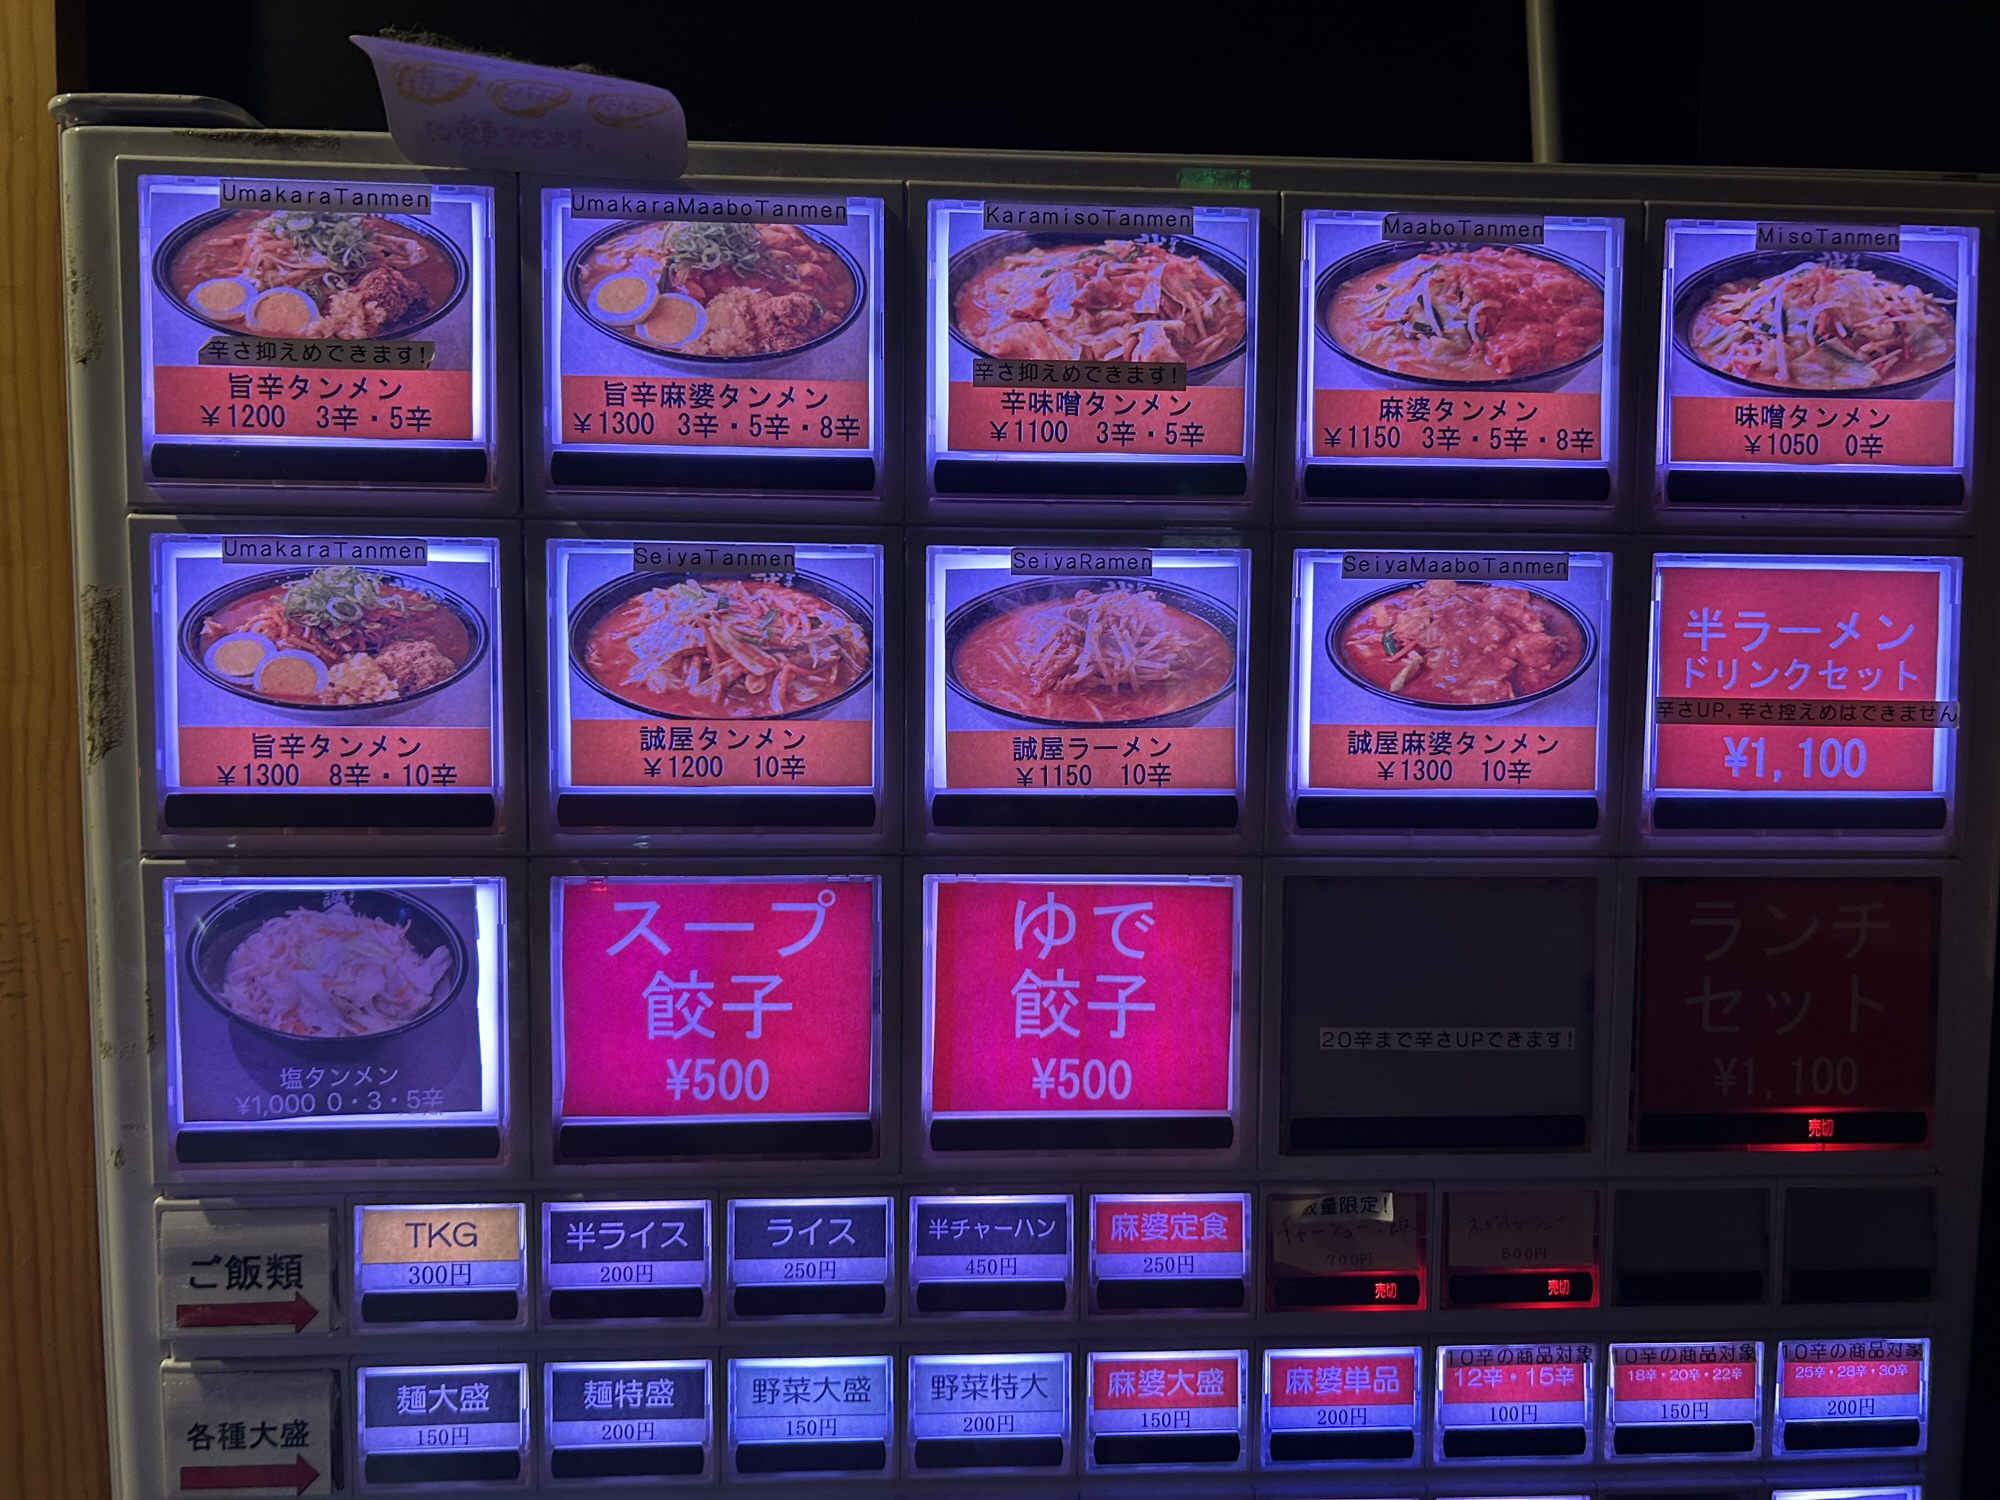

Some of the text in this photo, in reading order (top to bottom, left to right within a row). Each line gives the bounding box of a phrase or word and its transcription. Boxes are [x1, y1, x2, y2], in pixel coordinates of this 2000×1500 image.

[222, 184, 430, 208] UmakaraTanmen
[571, 194, 847, 219] UmakaraMaaboTanmen
[985, 206, 1192, 228] KaramisoTanmen
[1384, 217, 1543, 238] MaaboTanmen
[1758, 227, 1899, 247] MisoTanmen
[229, 374, 403, 400] 旨辛タンメン
[605, 381, 829, 410] 旨辛麻婆タンメン
[1001, 389, 1192, 416] 辛味噌タンメン
[1379, 396, 1538, 423] 麻婆タンメン
[201, 405, 286, 428] ¥1200
[573, 412, 655, 435] ¥1300
[1734, 404, 1891, 430] 味噌タンメン
[990, 420, 1069, 443] ¥1100
[1324, 425, 1401, 449] ¥1150
[1744, 433, 1884, 459] ¥1050 0辛
[224, 540, 426, 559] UmakaraTanmen
[634, 547, 795, 567] SeiyaTanmen
[1013, 552, 1151, 571] SeiyaRamen
[1343, 556, 1567, 575] SeiyaMaaboTanmen
[1683, 607, 1915, 651] 半ラーメン
[1685, 656, 1918, 690] ドリンクセット
[252, 733, 422, 760] 旨辛タンメン
[639, 725, 806, 752] 誠屋タンメン
[1012, 736, 1172, 762] 誠屋ラーメン
[1347, 730, 1559, 756] 誠屋麻婆タンメン
[643, 755, 806, 780] ¥1200 10辛
[1377, 759, 1532, 784] ¥1300 10辛
[1724, 736, 1867, 782] ¥1,100
[216, 763, 300, 786] ¥1300
[1016, 762, 1172, 787] ¥1150 10辛
[605, 888, 836, 957] スープ
[1013, 891, 1155, 960] ゆで
[1690, 900, 1890, 961] ランチ
[642, 969, 792, 1040] 餃子
[1010, 968, 1155, 1038] 餃子
[1684, 974, 1885, 1036] セット
[279, 1065, 398, 1089] 塩タンメン
[666, 1058, 769, 1101] ¥500
[1031, 1057, 1132, 1100] ¥500
[1808, 1118, 1834, 1138] 売切
[404, 1221, 478, 1249] TKG
[566, 1221, 688, 1252] 半ライス
[767, 1218, 856, 1247] ライス
[928, 1218, 1056, 1240] 半チャーハン
[1110, 1211, 1229, 1242] 麻婆定食
[189, 1253, 304, 1291] ご飯類
[408, 1262, 472, 1286] 300円
[600, 1264, 653, 1283] 200円
[784, 1260, 836, 1280] 250円
[965, 1257, 1017, 1276] 450円
[1143, 1254, 1194, 1274] 250円
[1374, 1281, 1397, 1299] 売切
[1547, 1278, 1570, 1297] 売切
[1449, 1345, 1594, 1366] 10辛の商品対象
[752, 1375, 871, 1405] 野菜大盛
[931, 1372, 1049, 1401] 野菜特大
[1107, 1368, 1224, 1398] 麻婆大盛
[1285, 1365, 1400, 1395] 麻婆単品
[396, 1382, 490, 1414] 麺大盛
[584, 1378, 675, 1410] 麺特盛
[1827, 1397, 1875, 1416] 200円
[1141, 1410, 1191, 1429] 150円
[1317, 1407, 1367, 1426] 200円
[1490, 1404, 1538, 1423] 100円
[1661, 1401, 1709, 1420] 150円
[187, 1418, 310, 1452] 各種大盛
[416, 1426, 469, 1446] 150円
[602, 1421, 655, 1441] 200円
[786, 1417, 837, 1437] 150円
[963, 1414, 1015, 1433] 200円
